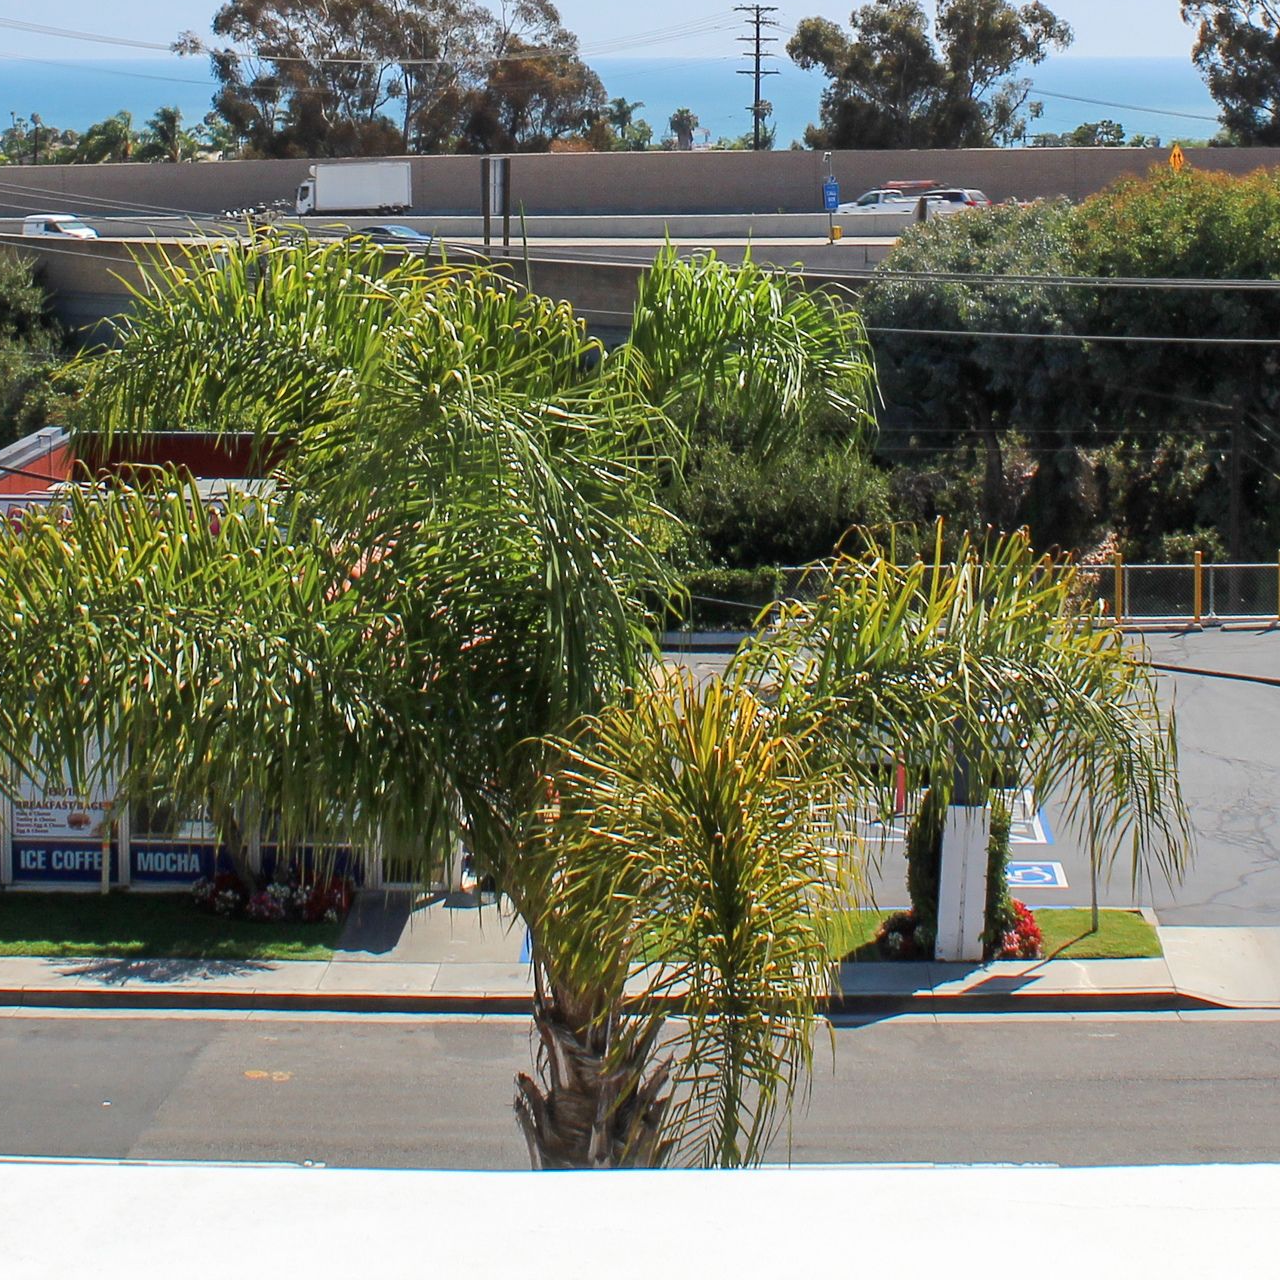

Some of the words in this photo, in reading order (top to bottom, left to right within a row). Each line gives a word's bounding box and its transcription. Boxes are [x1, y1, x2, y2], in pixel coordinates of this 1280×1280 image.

[20, 849, 46, 869] ICE
[51, 850, 109, 871] COFFE
[137, 852, 201, 873] MOCHA
